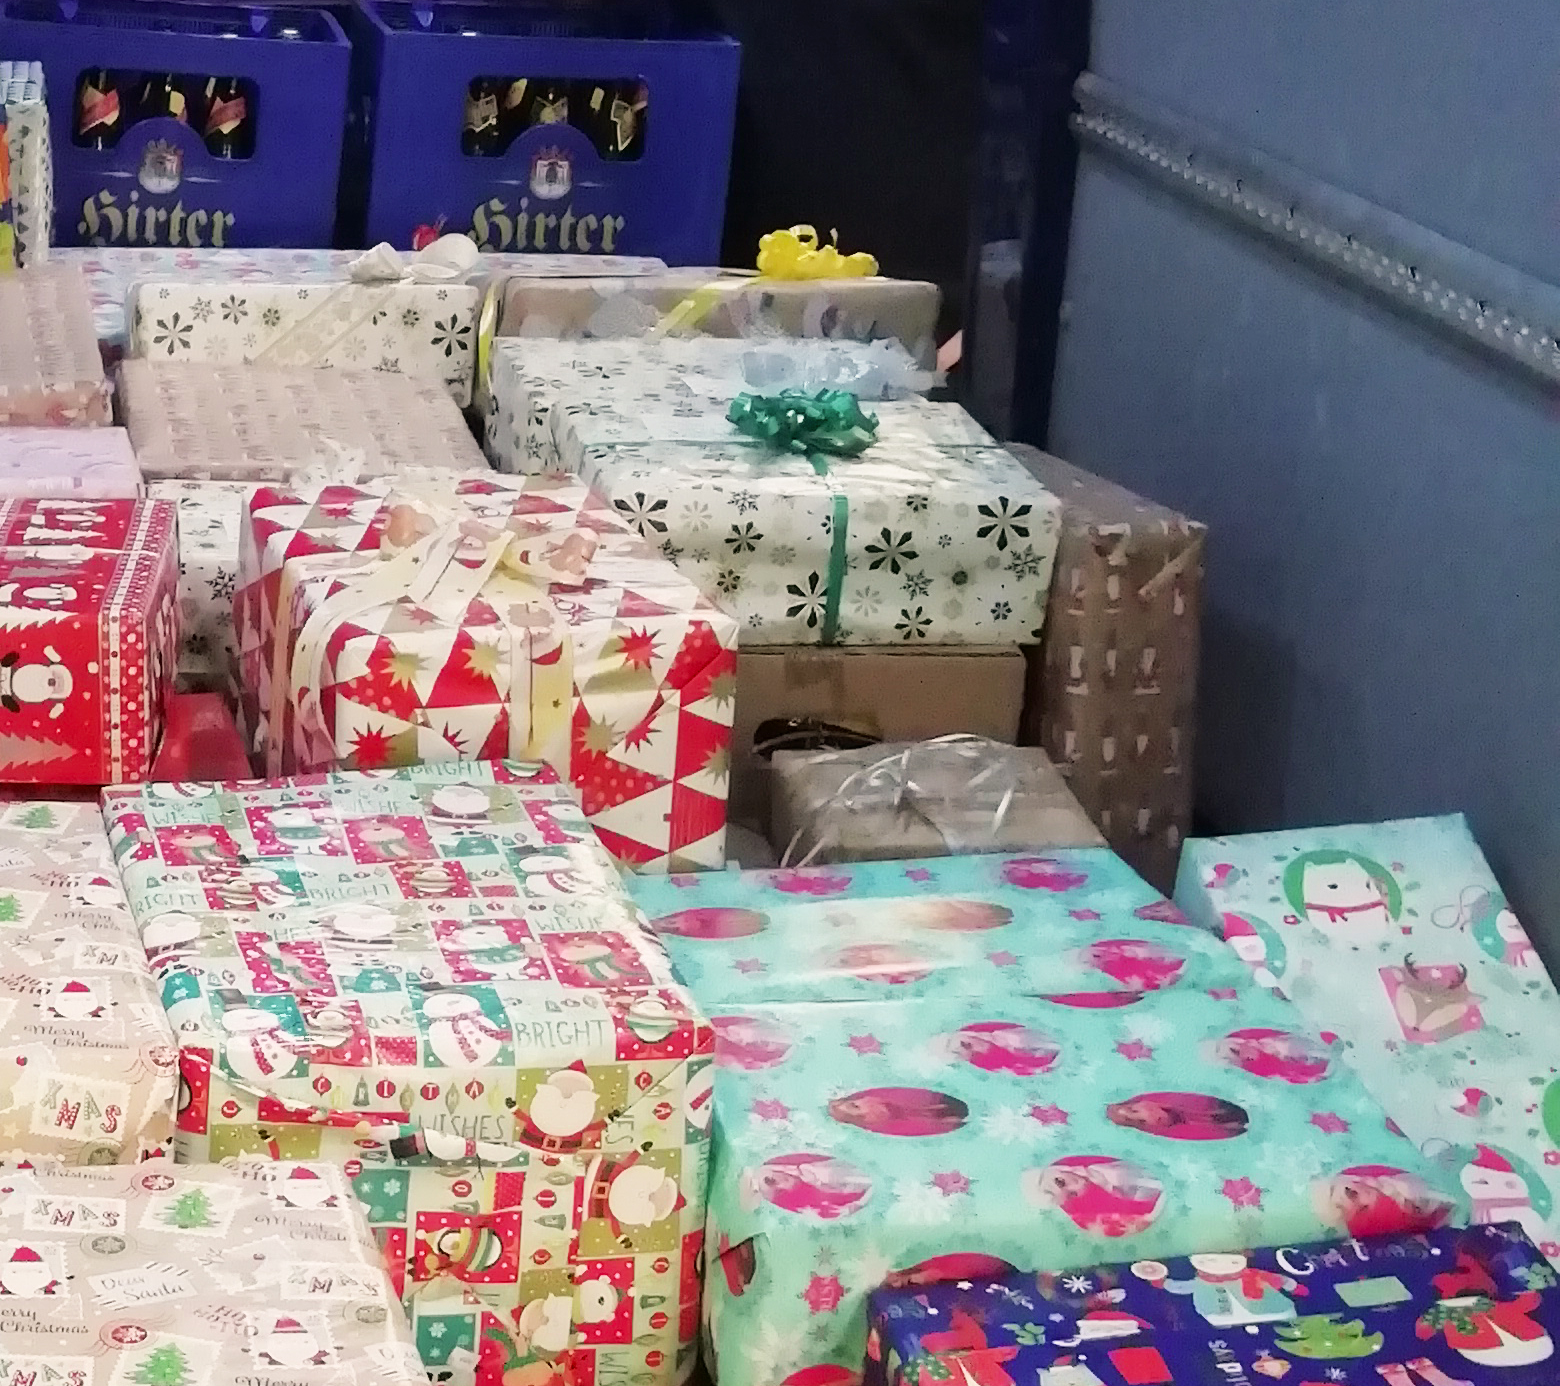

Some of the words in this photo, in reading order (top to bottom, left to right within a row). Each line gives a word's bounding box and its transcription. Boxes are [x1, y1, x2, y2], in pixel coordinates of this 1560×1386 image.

[77, 188, 236, 247] Hirter
[467, 197, 625, 253] Hirter
[515, 1019, 607, 1048] BRIGHT
[40, 1078, 122, 1134] XMAS
[32, 1199, 120, 1228] XMAS
